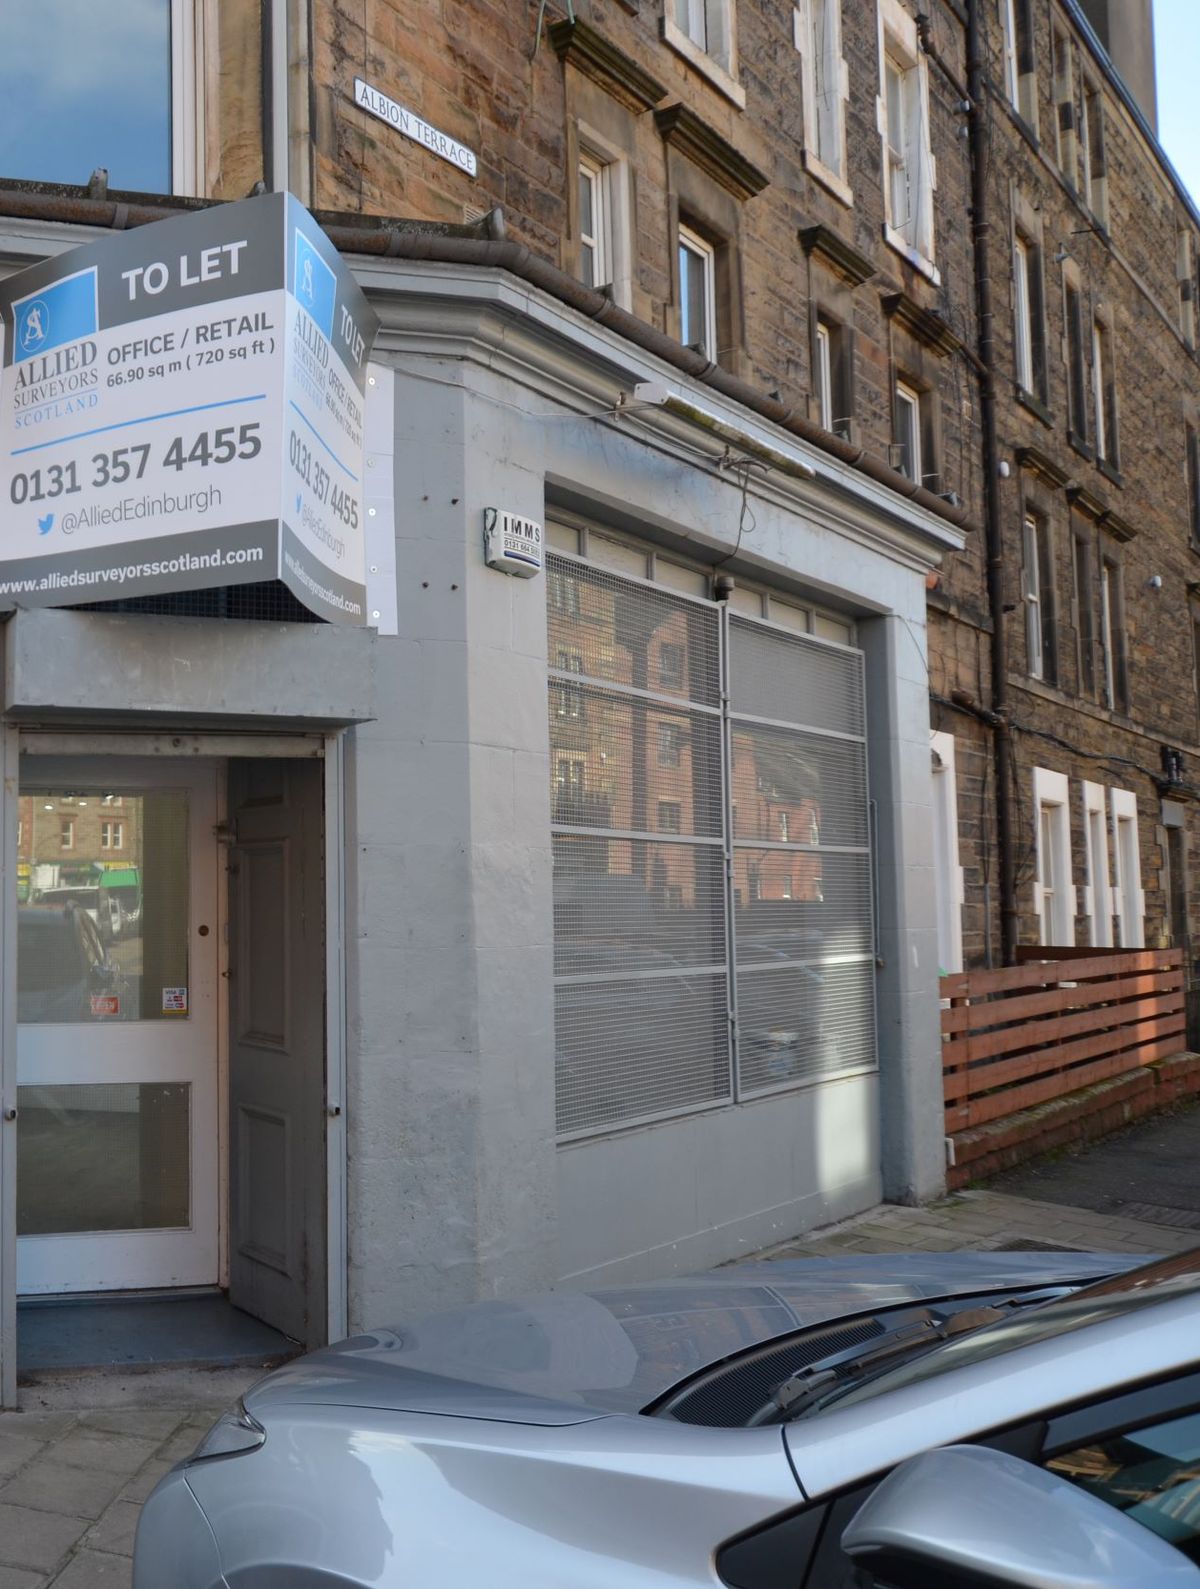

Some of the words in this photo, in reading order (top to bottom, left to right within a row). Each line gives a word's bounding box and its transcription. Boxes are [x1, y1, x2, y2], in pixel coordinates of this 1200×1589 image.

[360, 85, 409, 131] ALBION
[414, 119, 473, 171] TERRACE
[121, 262, 169, 301] TO
[179, 239, 248, 287] LET
[106, 366, 145, 388] 66.90
[148, 364, 165, 378] sq
[168, 360, 182, 373] m
[195, 348, 224, 367] 720
[228, 345, 247, 360] sq
[252, 340, 265, 355] ft
[107, 332, 175, 366] OFFICE
[195, 311, 274, 345] RETAIL
[294, 309, 329, 369] ALLIED
[340, 303, 352, 345] TO
[352, 325, 366, 369] LET
[13, 367, 98, 410] SURVEYORS
[14, 340, 98, 391] ALLIED
[14, 393, 98, 429] SCOTLAND
[10, 459, 82, 505] 0131
[91, 443, 152, 488] 357
[162, 422, 262, 472] 4455
[289, 430, 311, 487] 0131
[312, 460, 330, 505] 357
[330, 483, 358, 530] 4455
[61, 484, 222, 535] @AlliedEdinburgh
